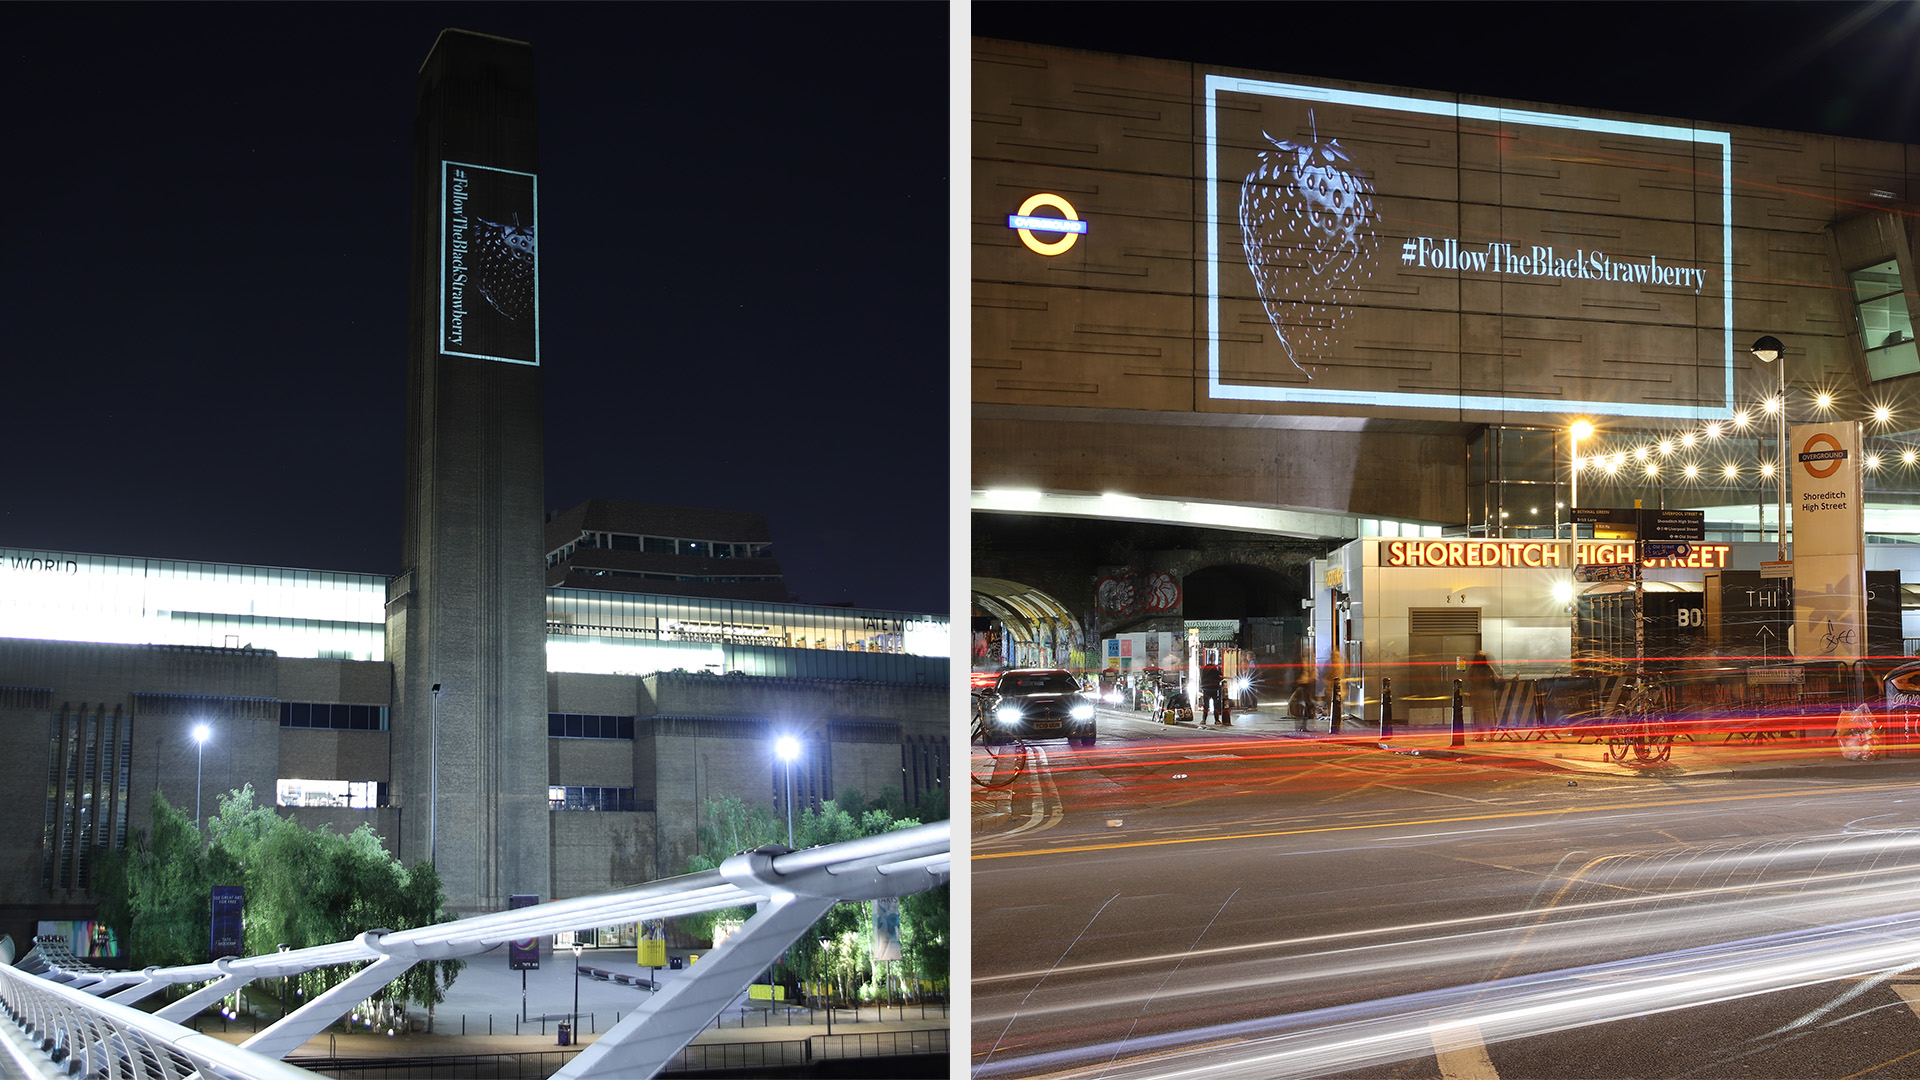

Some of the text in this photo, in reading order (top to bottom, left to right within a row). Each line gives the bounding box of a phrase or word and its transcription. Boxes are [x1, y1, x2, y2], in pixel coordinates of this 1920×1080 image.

[1014, 217, 1081, 232] OVERGROUND
[448, 169, 468, 346] #FollowTheBlackStrawberry
[1401, 236, 1706, 295] #FollowTheBlackStrawberry
[1801, 451, 1844, 461] OVERGROUND
[1803, 491, 1846, 501] Shoreditch
[1802, 502, 1847, 512] High Street
[1389, 541, 1560, 567] SHOREDITCH
[1577, 543, 1634, 565] HIGH
[860, 616, 888, 631] TATE
[1677, 608, 1704, 627] BO
